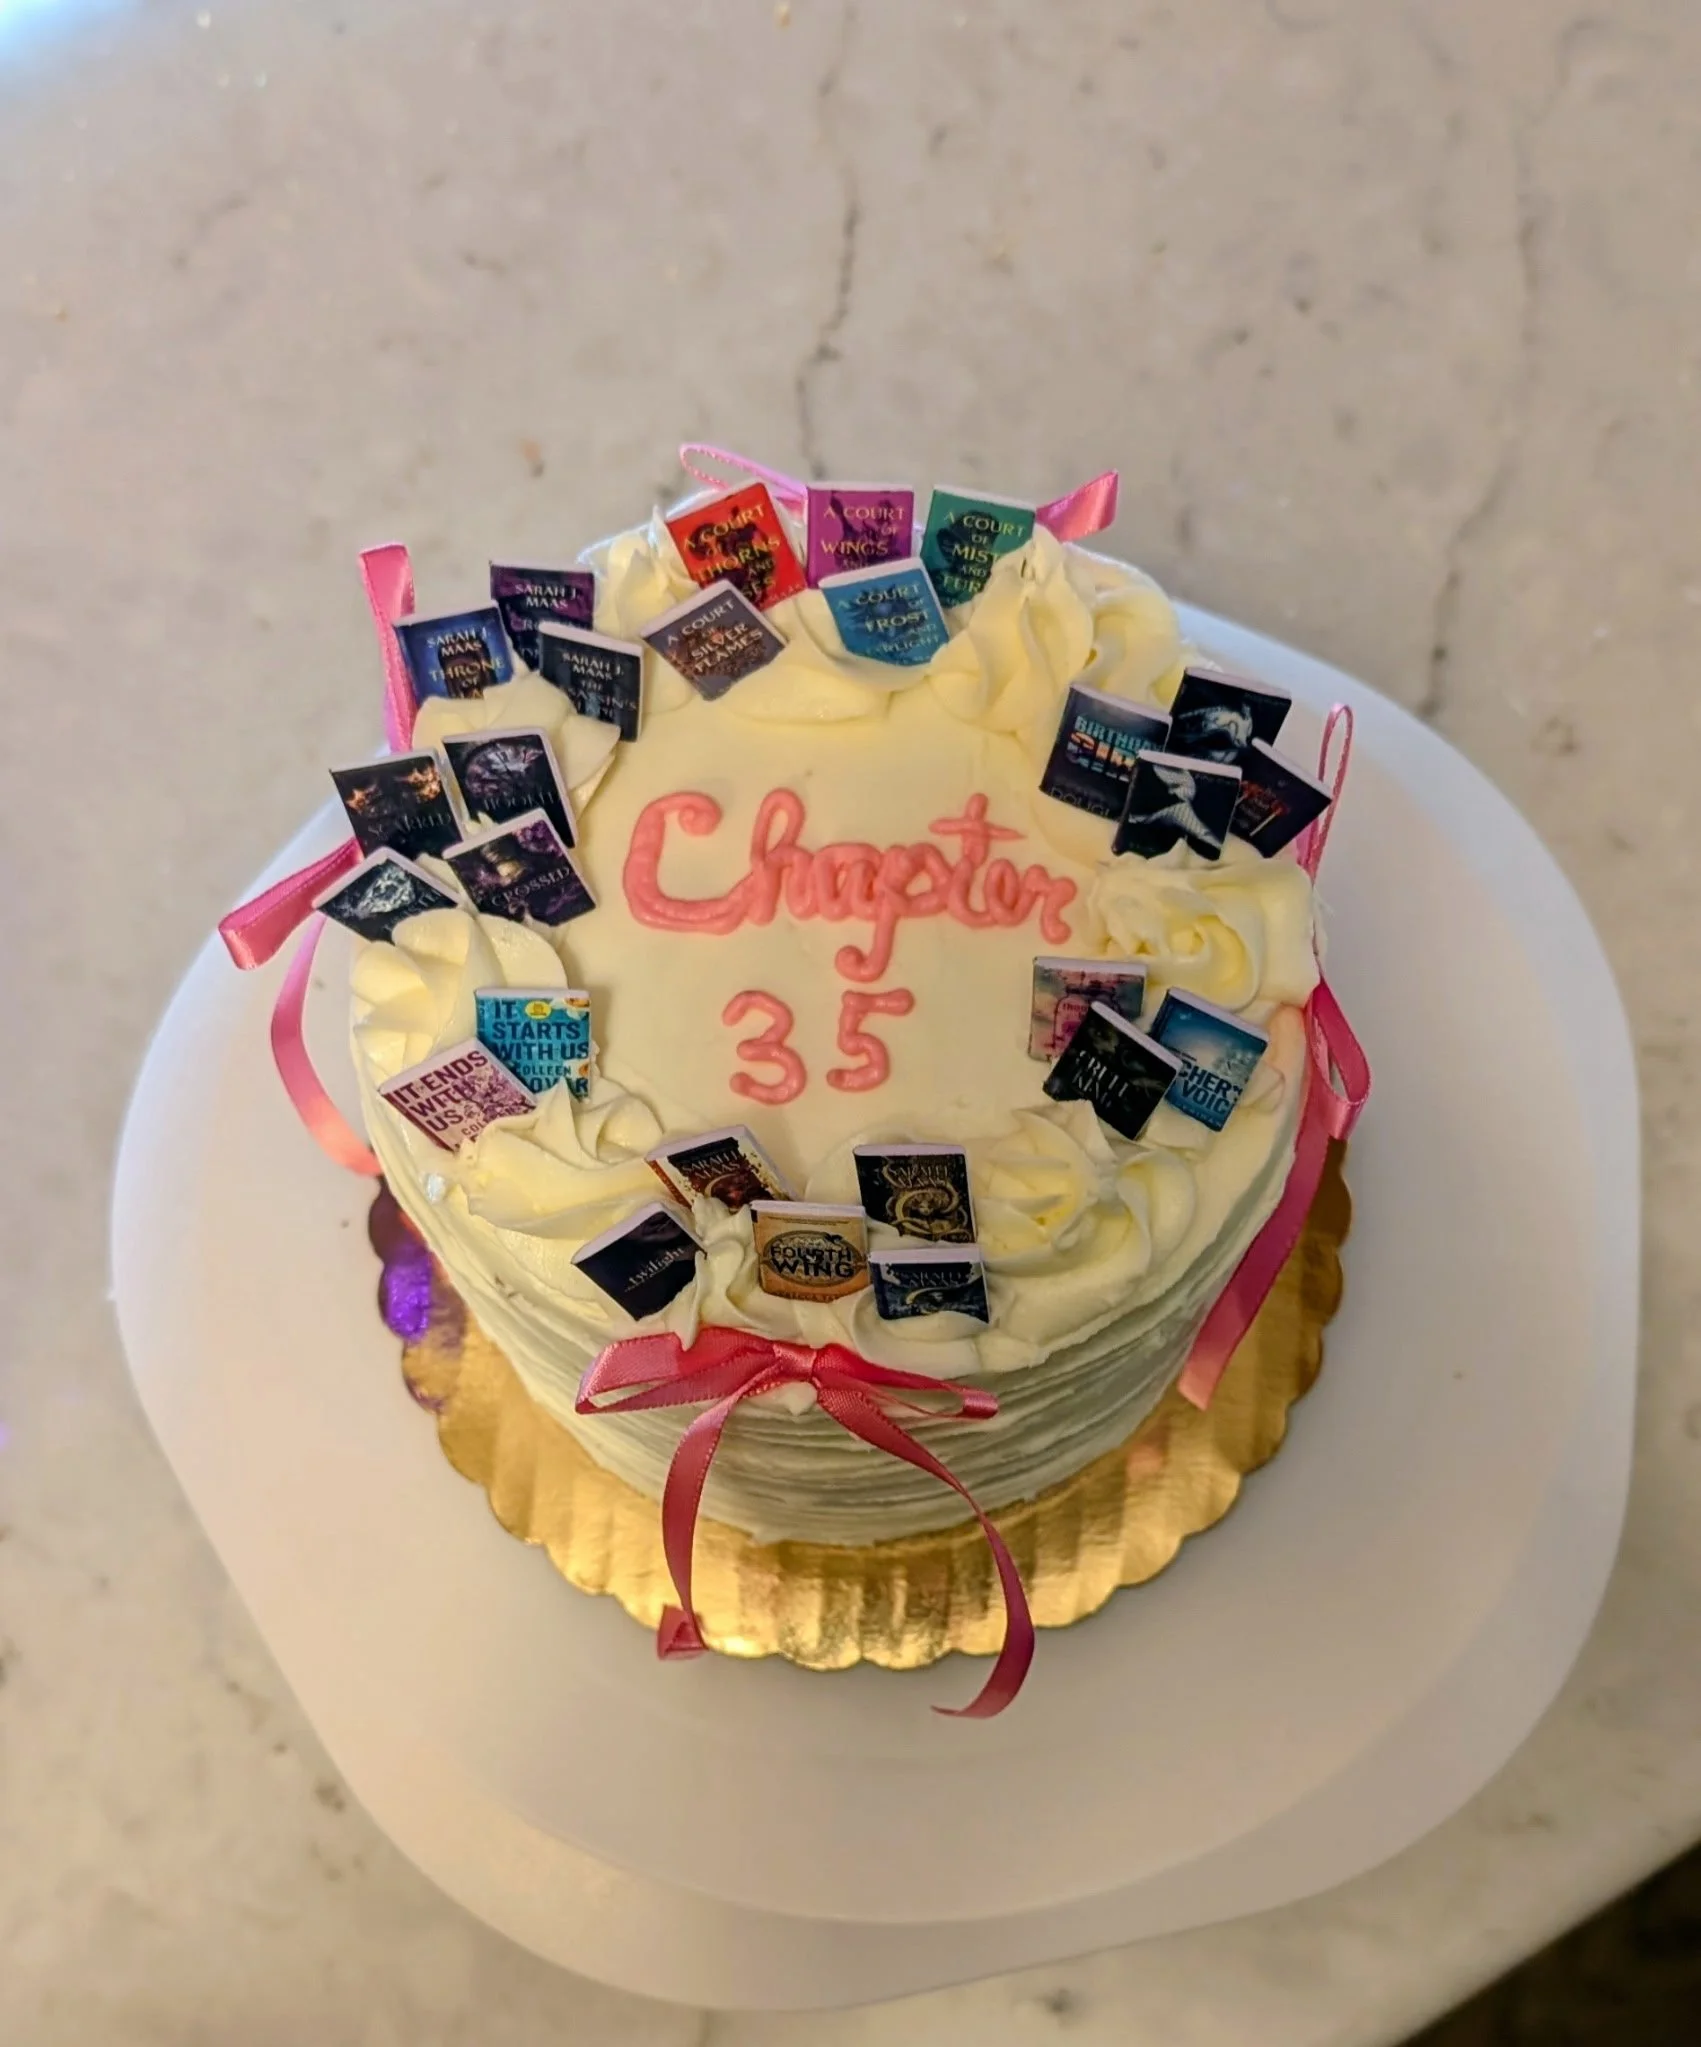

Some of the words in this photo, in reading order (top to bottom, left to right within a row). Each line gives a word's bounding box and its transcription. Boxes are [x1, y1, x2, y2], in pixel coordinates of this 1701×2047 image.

[823, 506, 836, 520] A
[843, 506, 905, 521] COURT
[943, 511, 956, 524] A
[962, 515, 1026, 538] COURT
[684, 537, 696, 553] A
[700, 504, 765, 542] COURT
[820, 538, 889, 556] WINGS
[698, 537, 780, 582] THORNS
[515, 583, 566, 598] SARAH
[855, 583, 920, 605] COURT
[525, 596, 569, 609] MAAS
[667, 634, 680, 647] A
[681, 600, 735, 635] COURT
[864, 610, 929, 633] FROST
[426, 628, 477, 649] SARAH
[441, 642, 482, 657] MAAS
[691, 622, 749, 661] SILVER
[562, 651, 611, 672] SARAH
[694, 628, 764, 673] FLAMES
[428, 656, 505, 682] THRONE
[572, 663, 613, 681] MAAS
[623, 787, 1078, 983] Chapter
[494, 1000, 517, 1020] IT
[492, 1021, 582, 1041] STARTS
[492, 1042, 554, 1061] WITH
[560, 1042, 590, 1060] US
[393, 1082, 421, 1106] IT
[420, 1050, 489, 1092] ENDS
[409, 1080, 477, 1118] WITH
[1181, 1079, 1231, 1115] VOIC
[426, 1109, 465, 1133] US
[770, 1245, 853, 1262] FOURTH
[628, 1246, 686, 1286] twilight
[771, 1258, 855, 1279] WING
